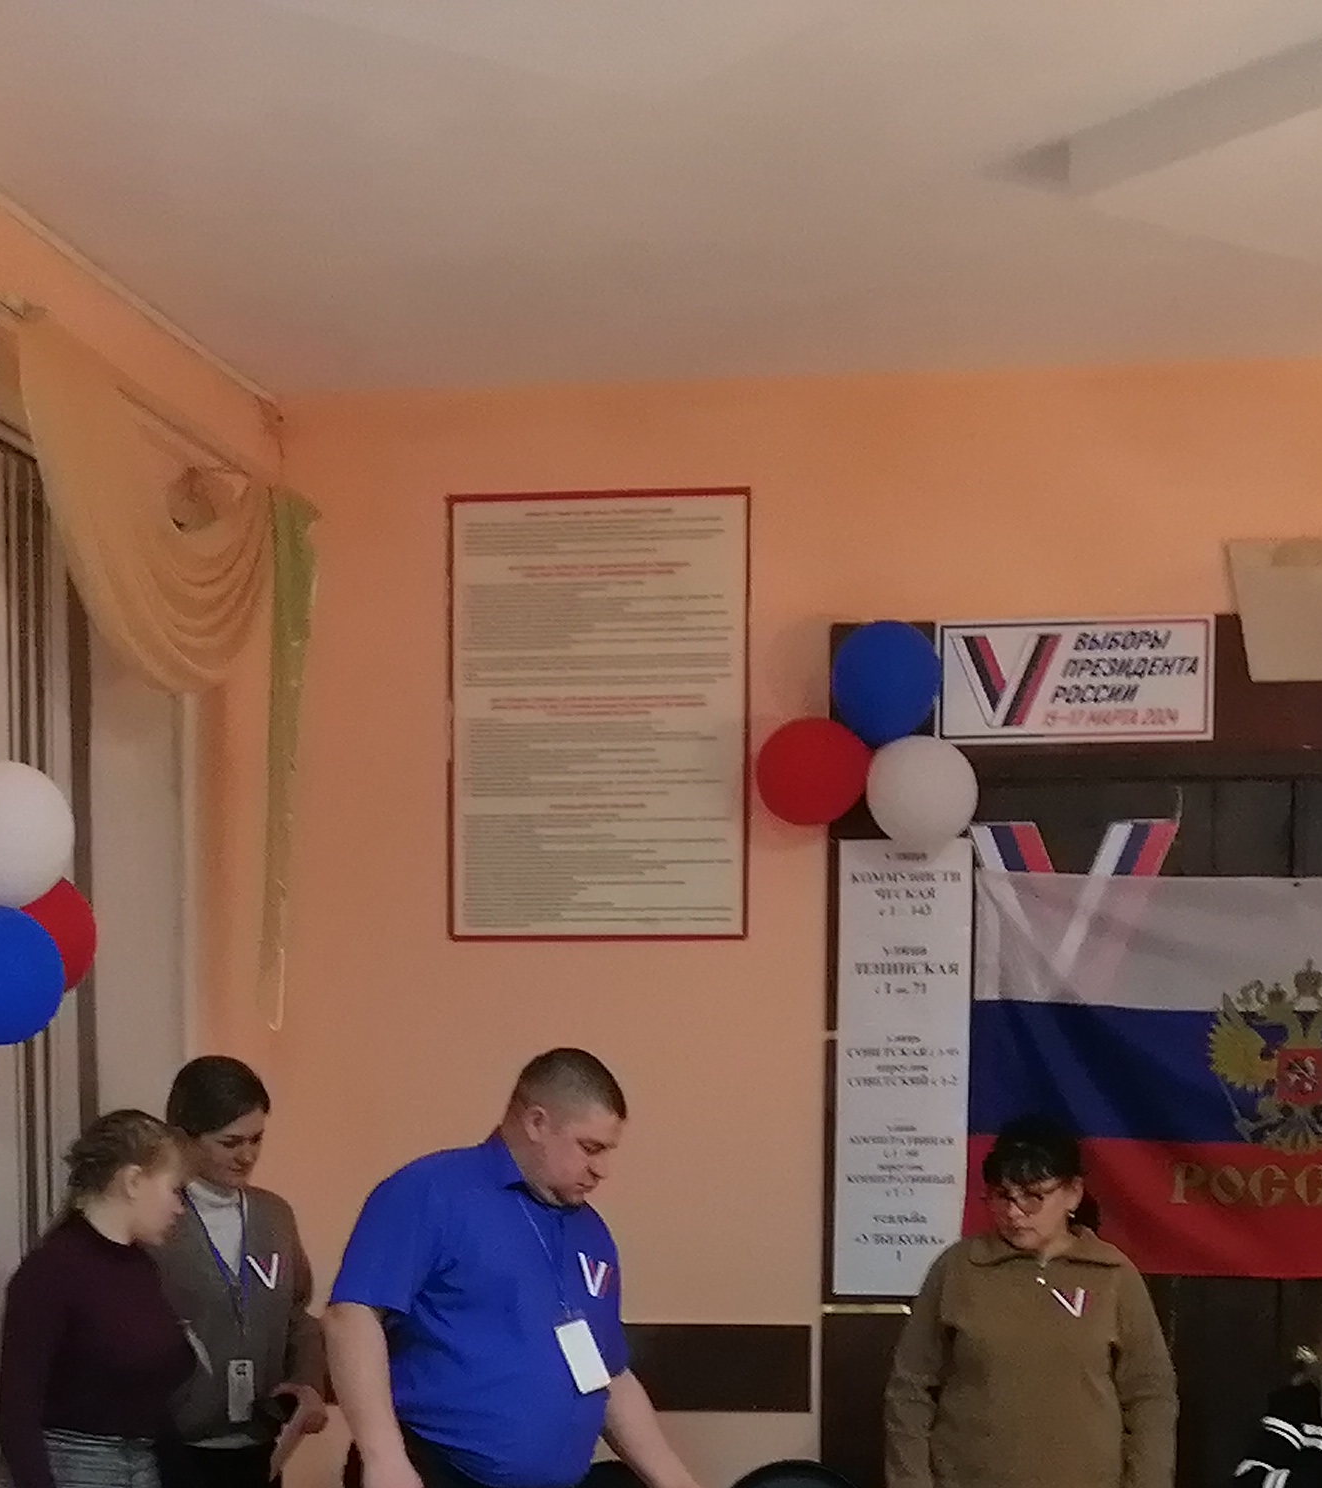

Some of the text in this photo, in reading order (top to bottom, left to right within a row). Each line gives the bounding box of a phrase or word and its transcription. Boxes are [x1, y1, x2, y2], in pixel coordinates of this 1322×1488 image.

[1073, 629, 1171, 651] ВЫБОРЫ
[1060, 656, 1199, 680] ПРЕЗИДЕНТА
[1050, 683, 1139, 704] РОССИИ
